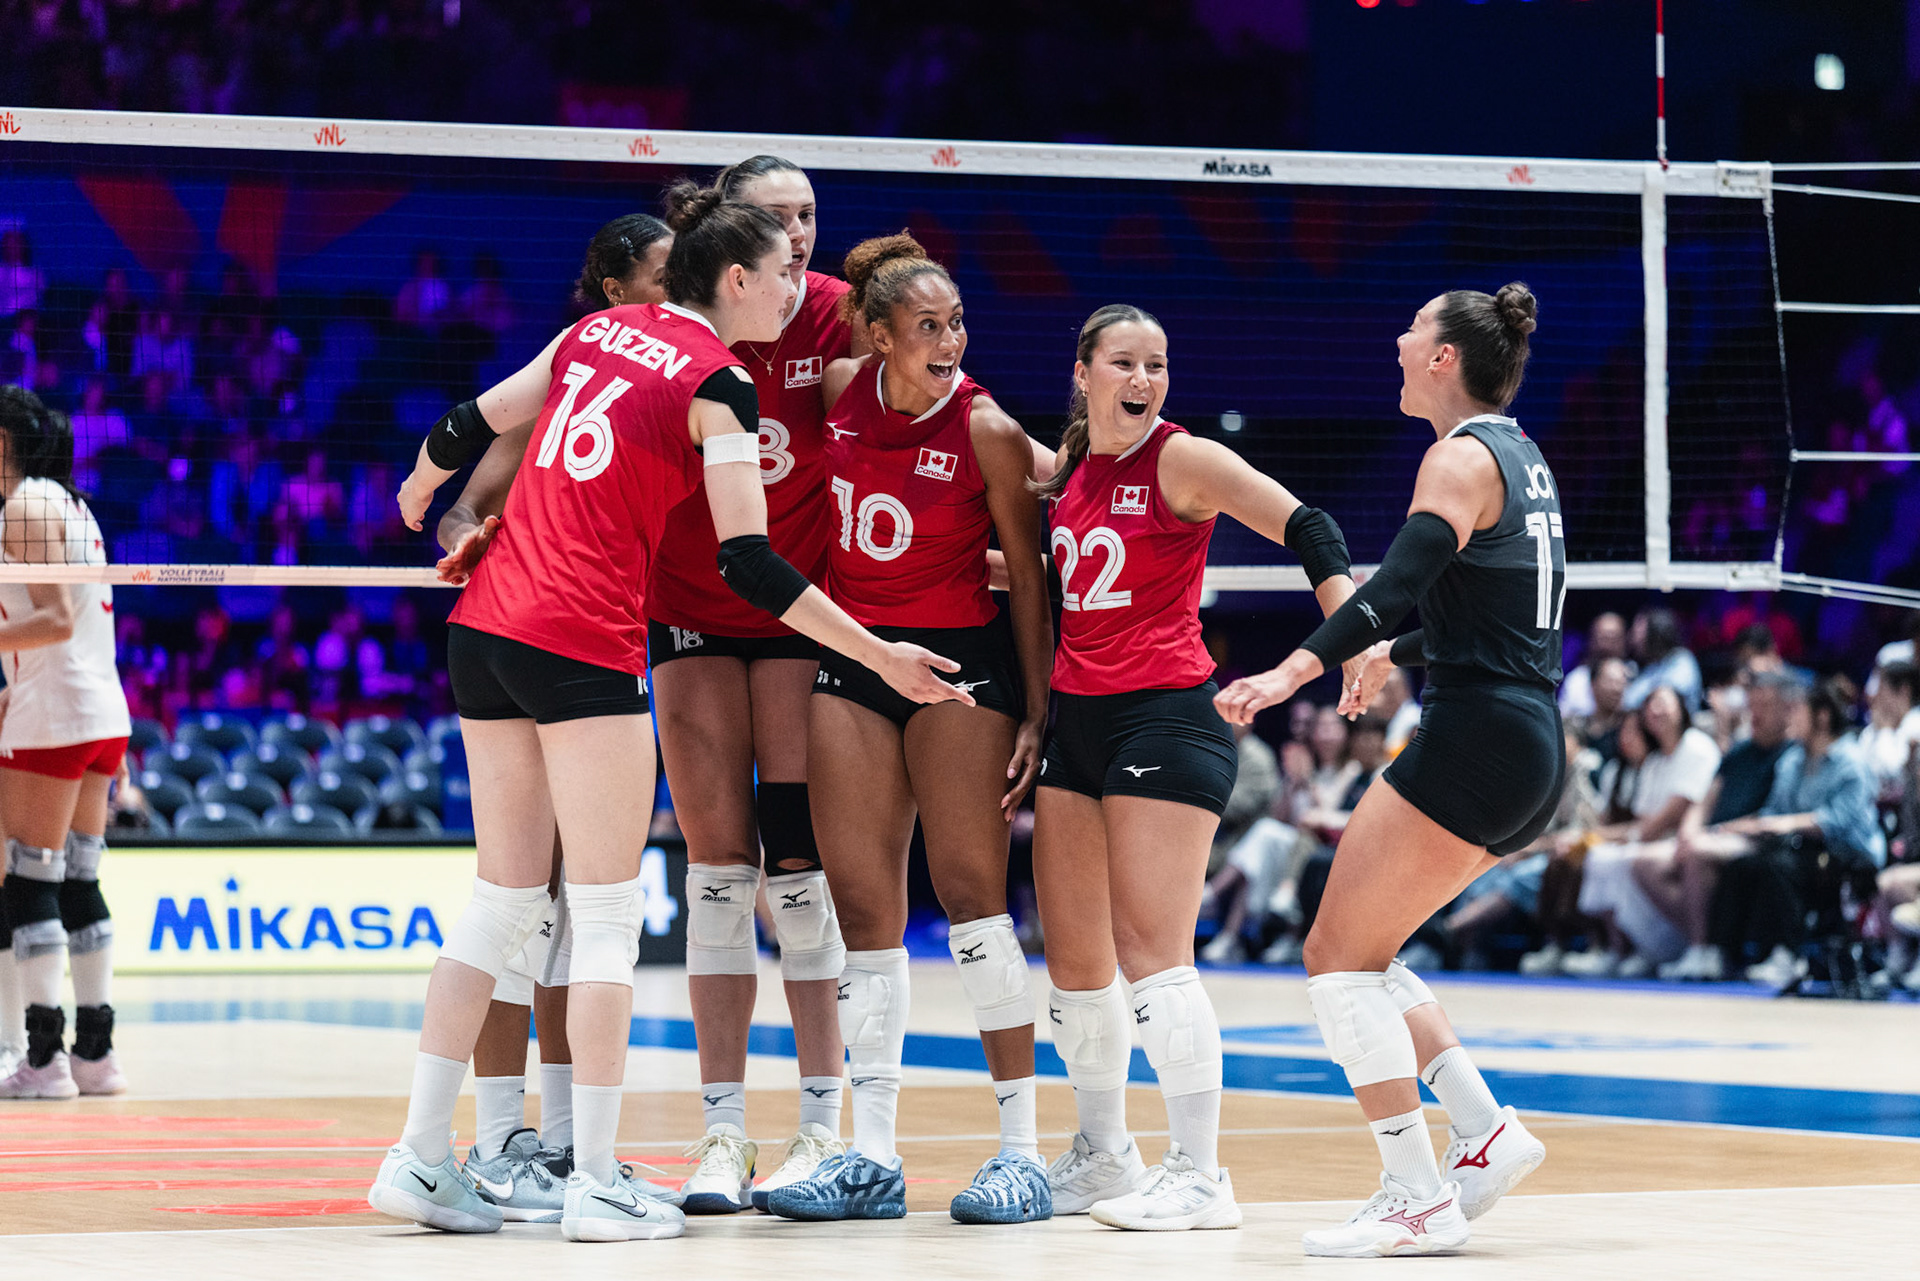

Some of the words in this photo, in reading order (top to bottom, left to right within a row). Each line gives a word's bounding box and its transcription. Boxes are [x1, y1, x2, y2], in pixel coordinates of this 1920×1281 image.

[0, 112, 20, 134] NL
[579, 316, 692, 380] GUEZEN
[786, 376, 820, 387] Canada
[535, 361, 632, 481] 16
[917, 466, 951, 481] Canada
[831, 475, 914, 561] 10
[1112, 505, 1145, 514] Canada
[160, 569, 225, 577] VOLLEYBALL
[1051, 526, 1132, 611] 22
[669, 626, 703, 652] 18
[148, 877, 445, 951] MIKASA
